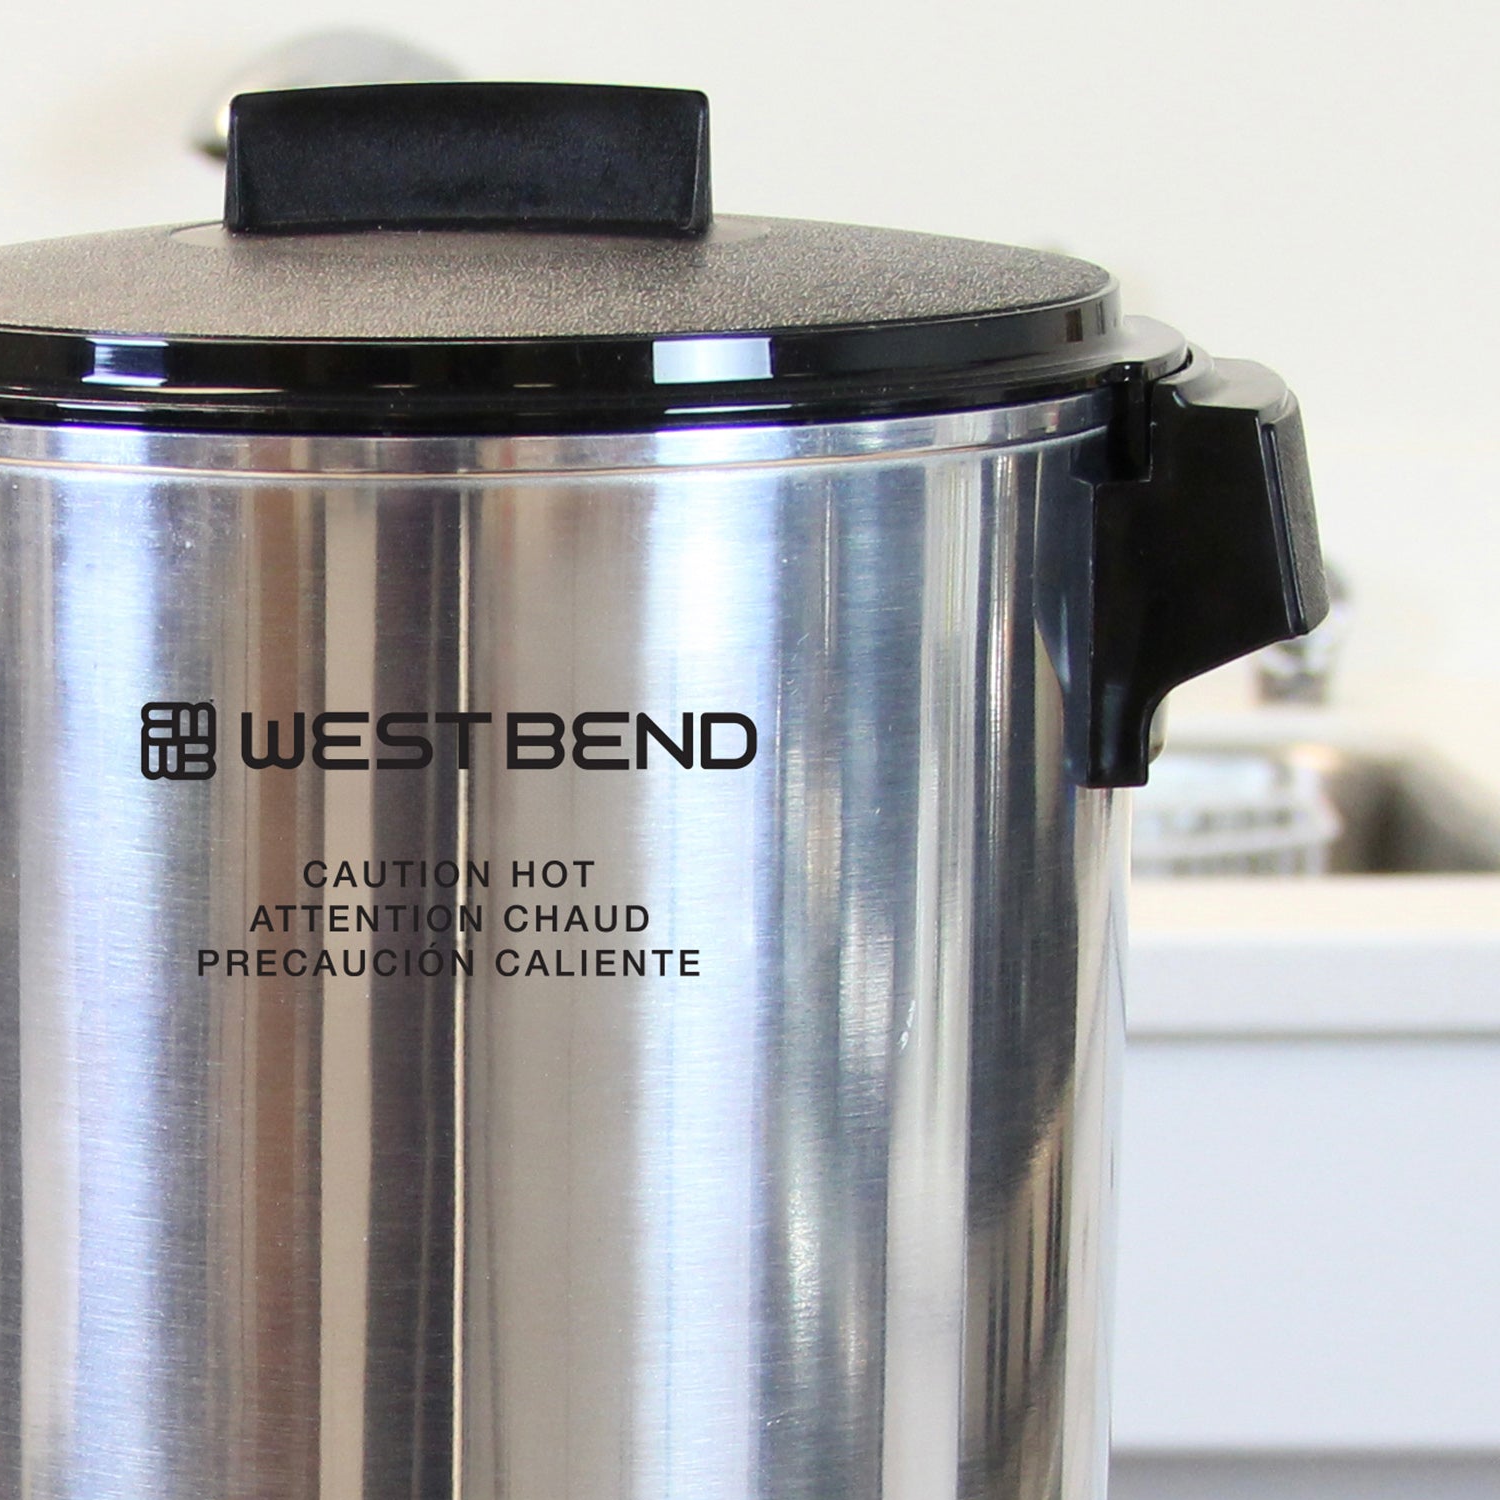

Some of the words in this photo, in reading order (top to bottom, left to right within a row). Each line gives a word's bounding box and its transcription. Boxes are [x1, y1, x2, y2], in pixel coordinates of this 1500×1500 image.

[241, 711, 492, 770] WEST
[506, 711, 758, 770] BEND
[303, 860, 490, 888] CAUTION
[512, 860, 595, 888] HOT
[249, 905, 483, 932] ATTENTION
[503, 905, 650, 932] CHAUD
[198, 942, 474, 977] PRECAUCIÓN
[494, 949, 701, 977] CALIENTE
